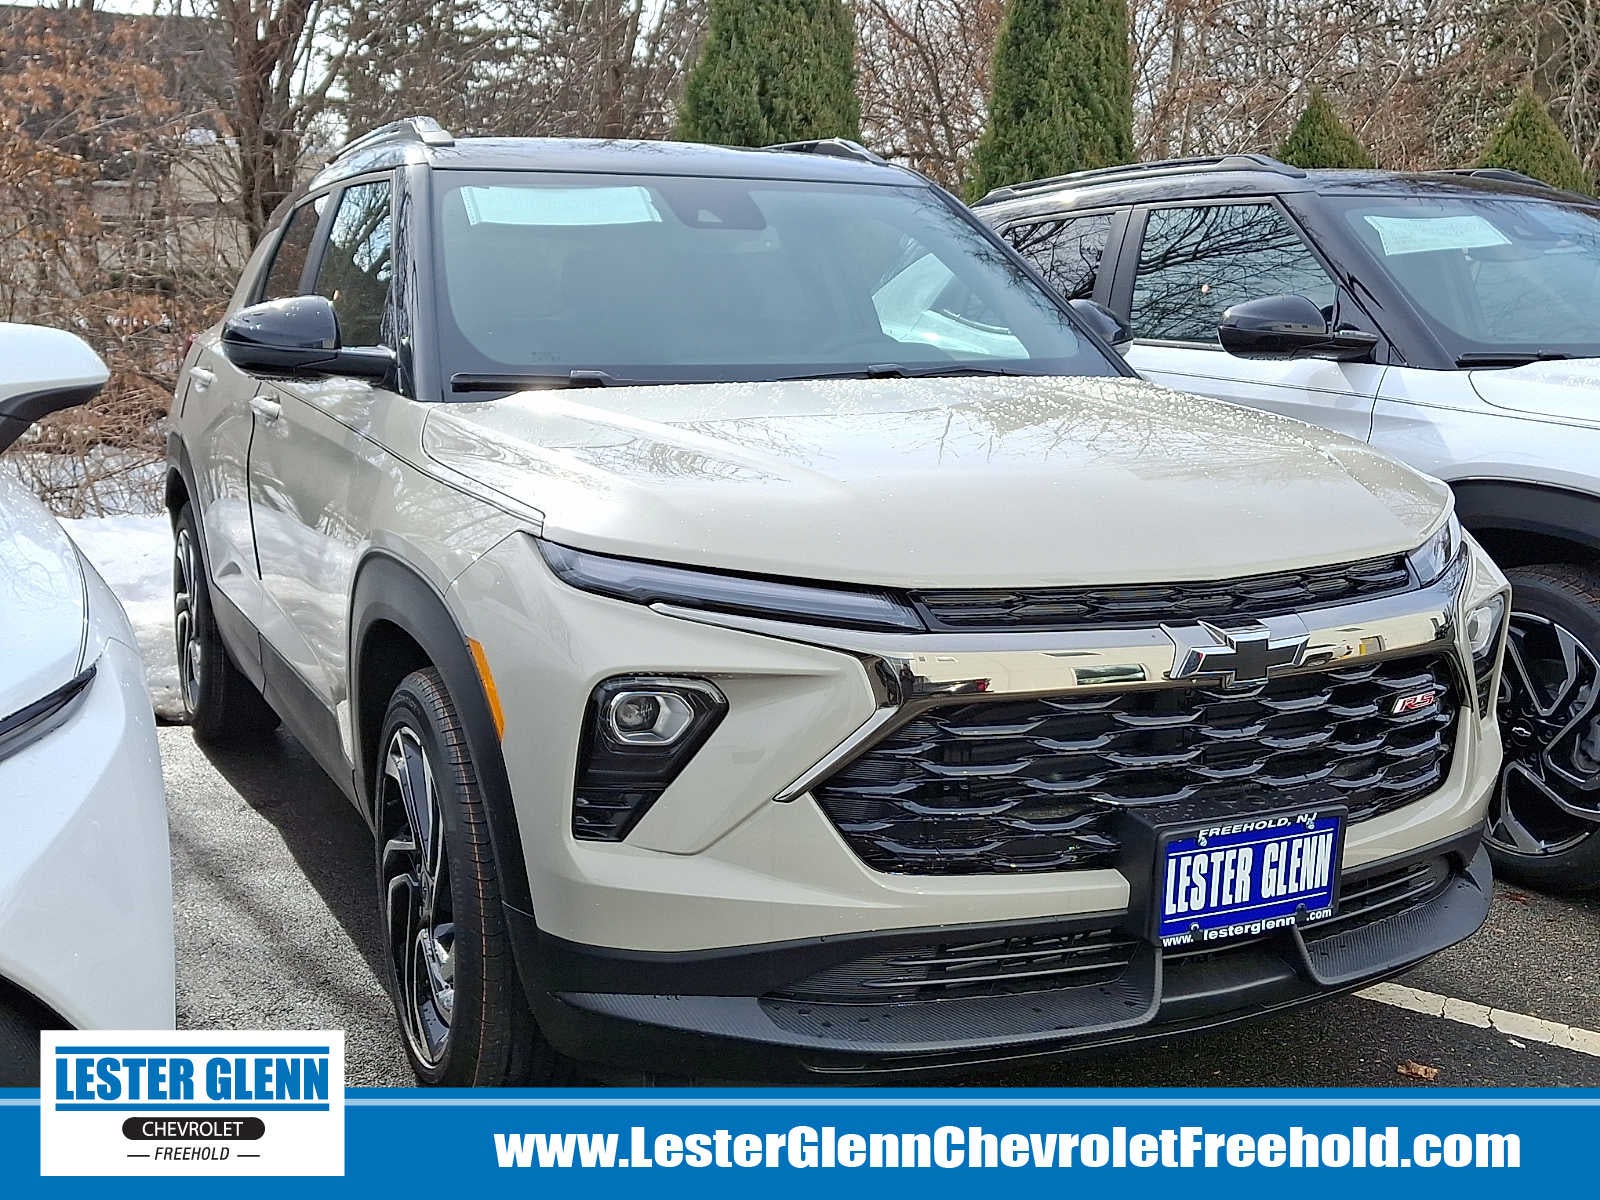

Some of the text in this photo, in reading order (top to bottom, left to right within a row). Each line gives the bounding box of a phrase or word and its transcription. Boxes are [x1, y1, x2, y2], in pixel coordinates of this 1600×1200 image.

[1398, 693, 1436, 712] RS
[1199, 818, 1291, 839] FREEHOLD,
[1165, 832, 1333, 915] LESTER GLENN
